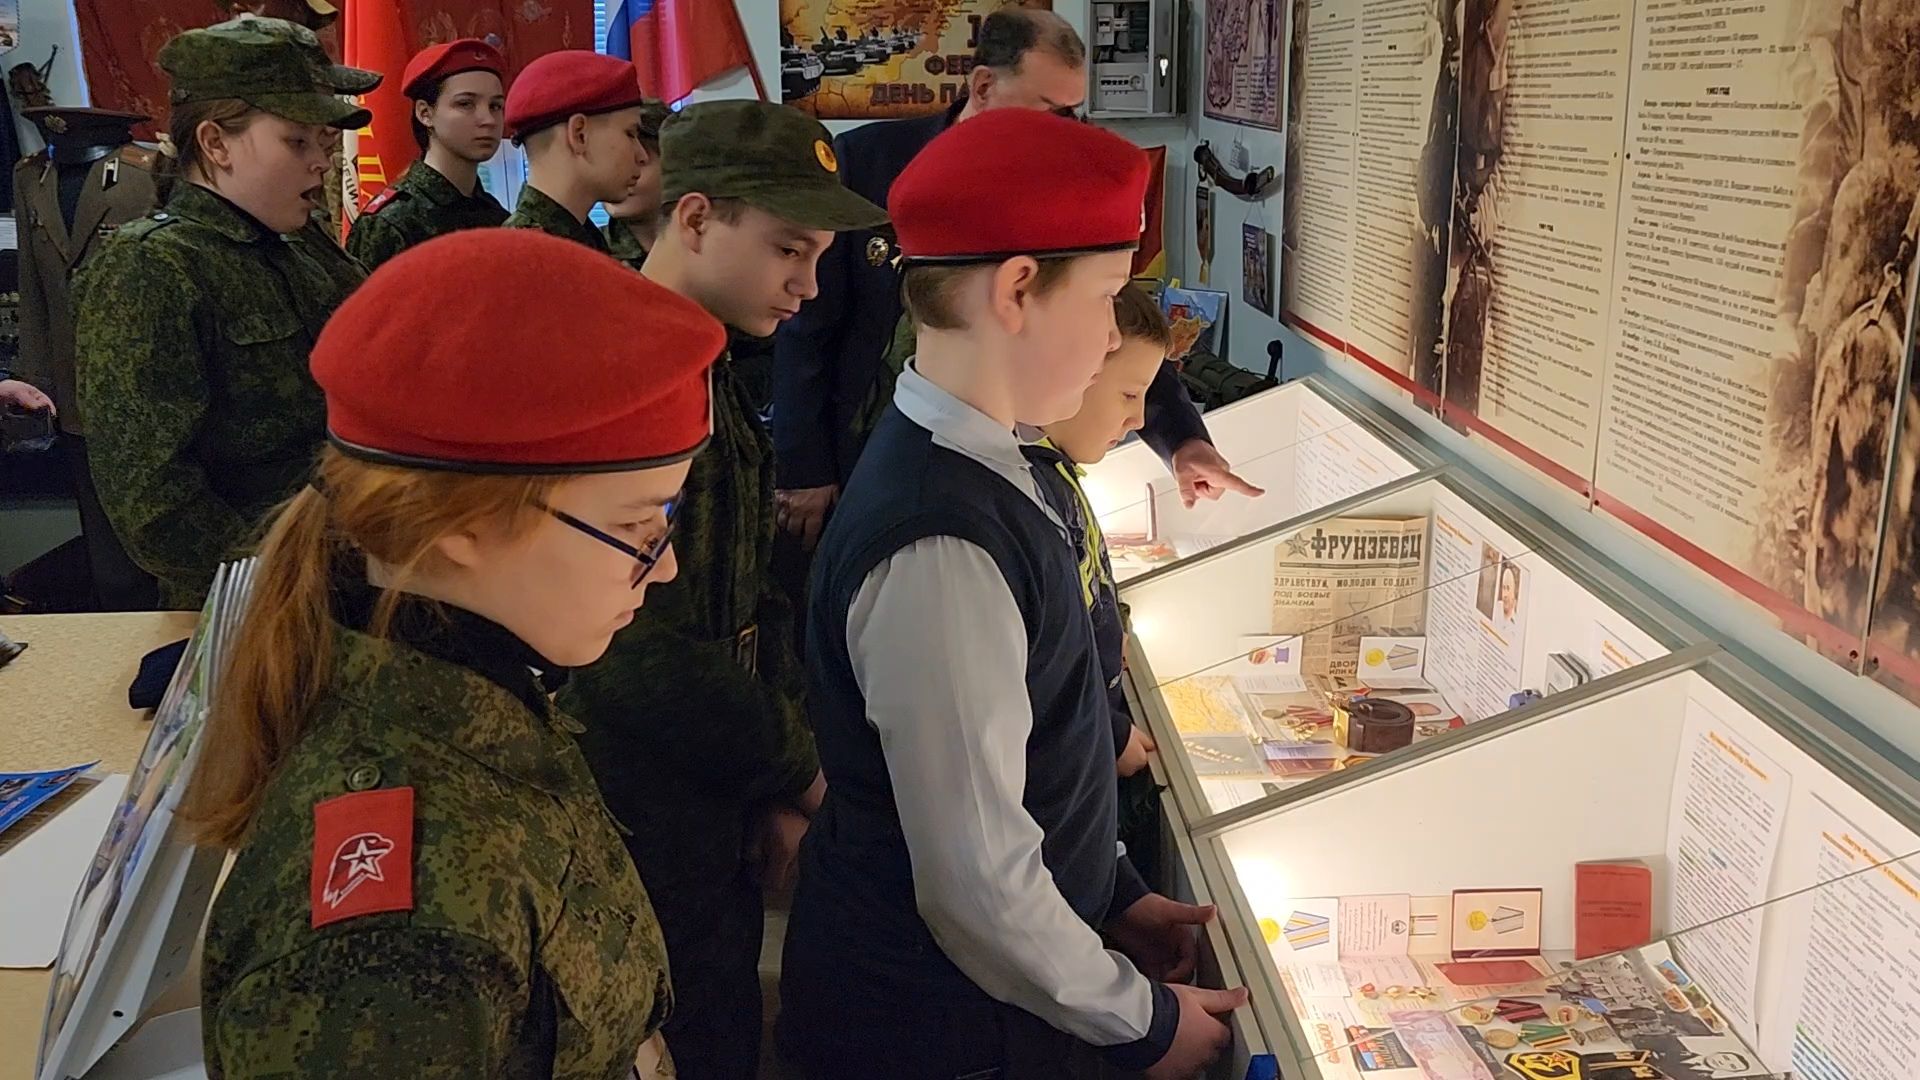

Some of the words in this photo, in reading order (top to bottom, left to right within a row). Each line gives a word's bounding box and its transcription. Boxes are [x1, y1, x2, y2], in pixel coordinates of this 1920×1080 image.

[870, 83, 935, 105] ДЕНЬ
[1311, 528, 1422, 560] ФРУНЗЕВЕЦ
[1330, 661, 1356, 669] ДВОР
